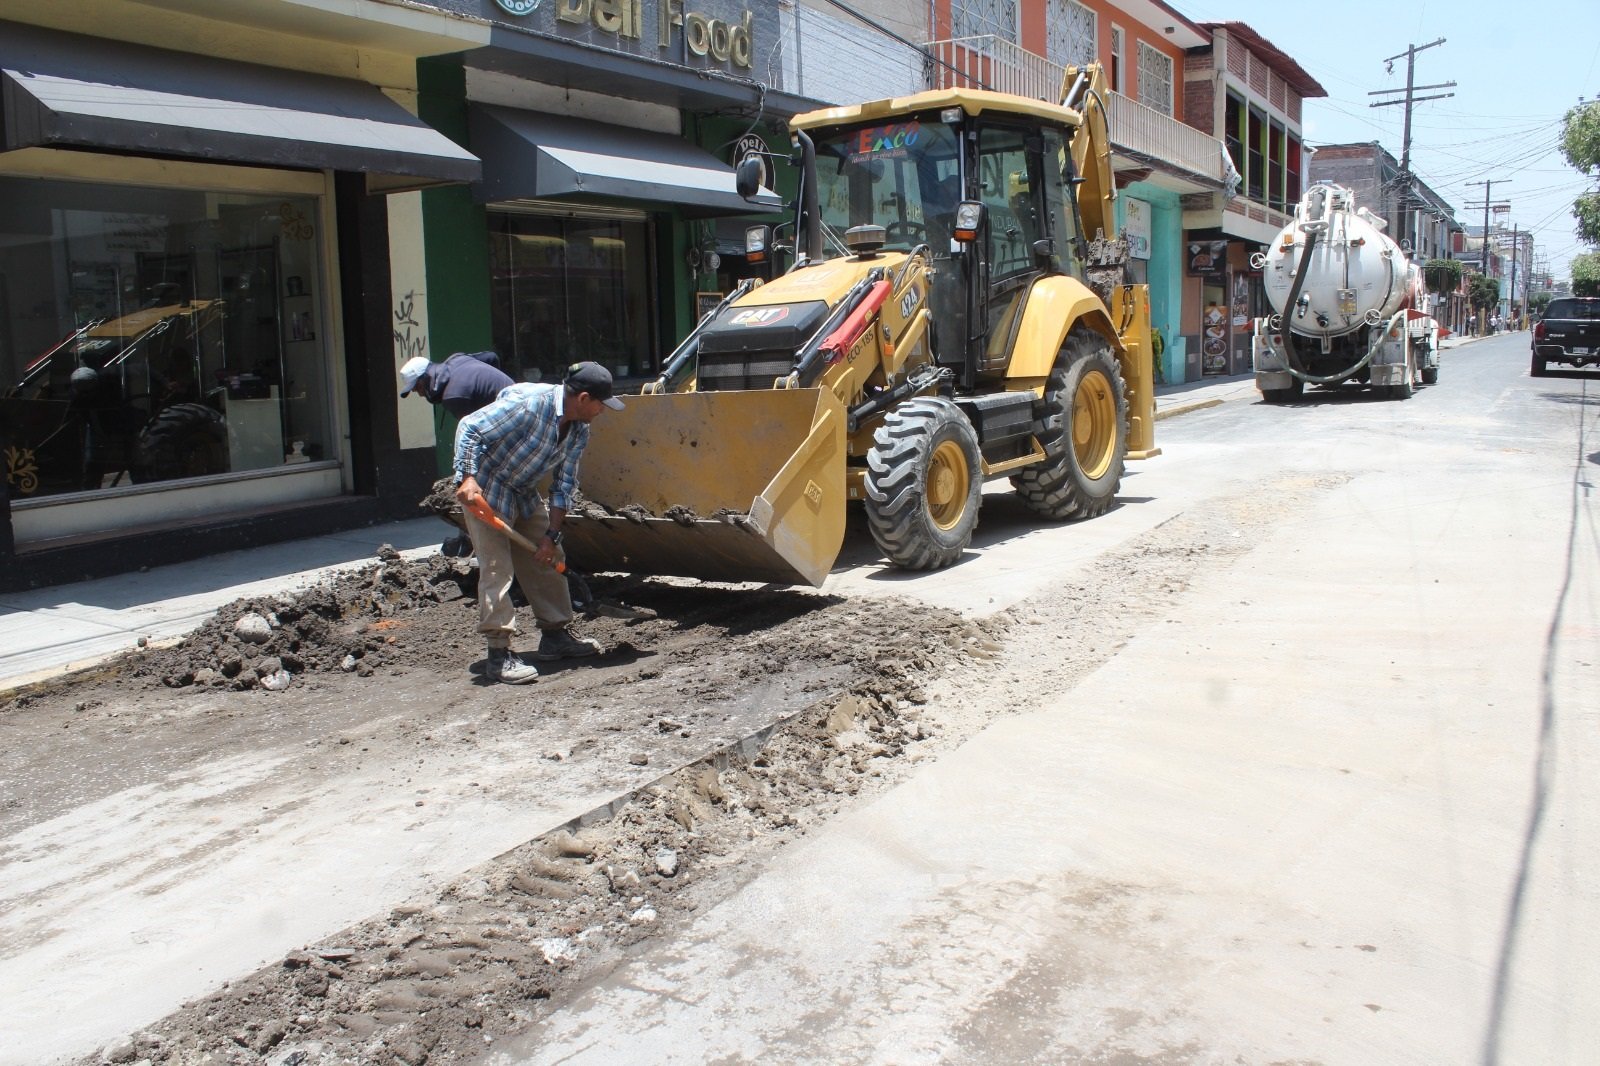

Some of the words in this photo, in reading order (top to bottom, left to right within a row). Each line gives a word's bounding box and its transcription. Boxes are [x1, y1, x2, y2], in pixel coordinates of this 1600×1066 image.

[658, 0, 753, 68] Food
[740, 138, 765, 153] Deli
[731, 308, 783, 325] CAT
[901, 288, 919, 319] 424
[846, 331, 874, 364] ECO-185
